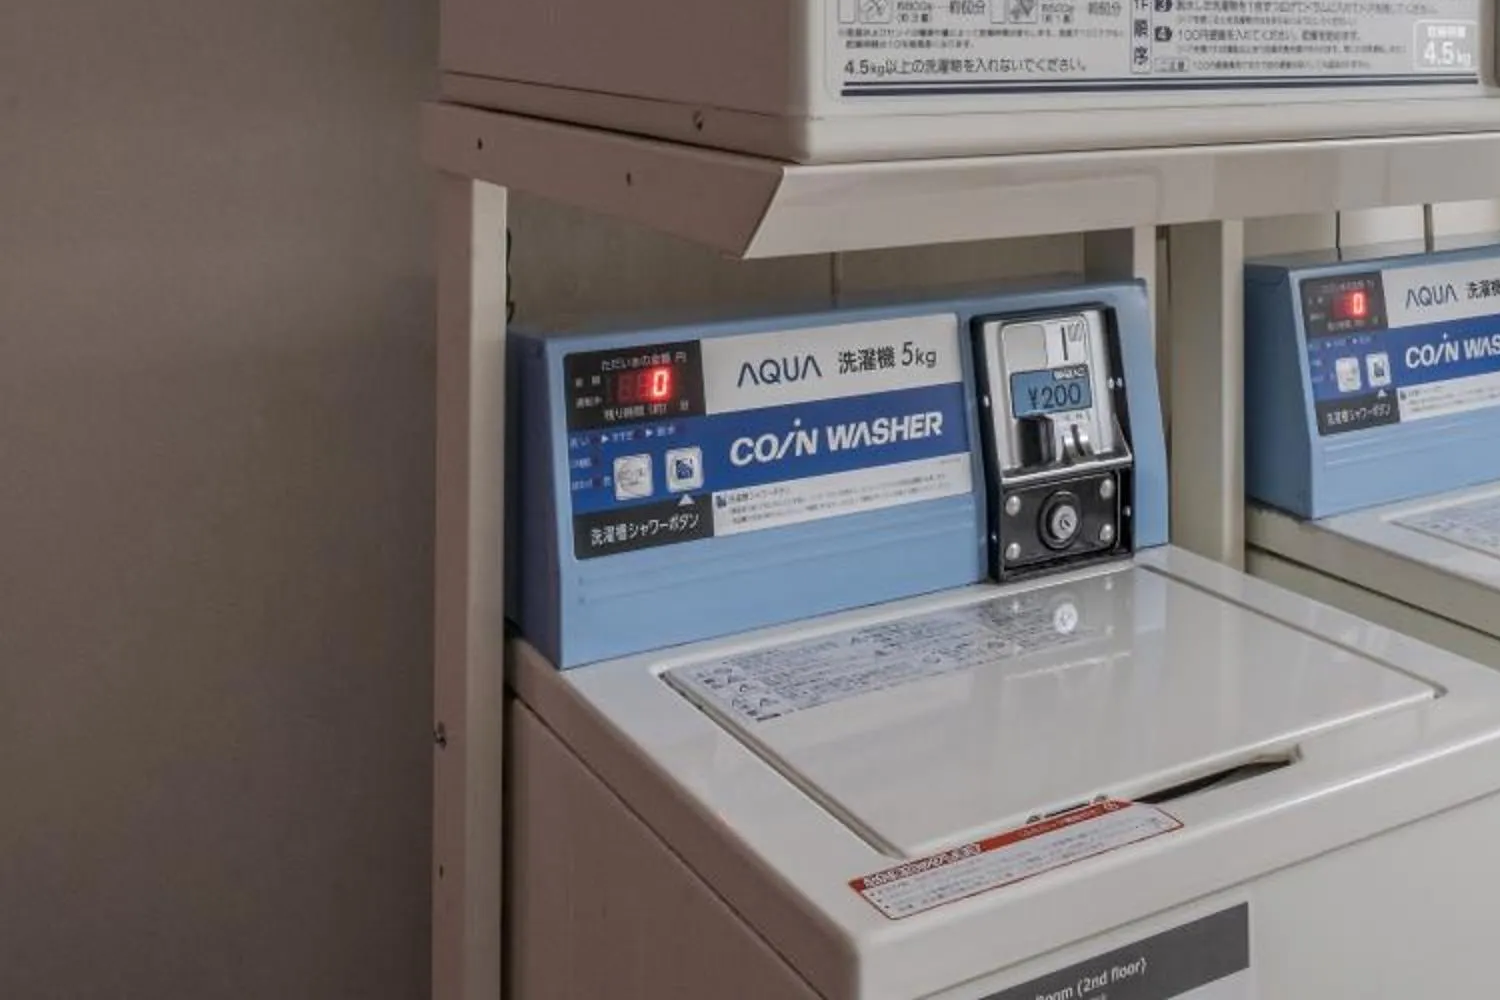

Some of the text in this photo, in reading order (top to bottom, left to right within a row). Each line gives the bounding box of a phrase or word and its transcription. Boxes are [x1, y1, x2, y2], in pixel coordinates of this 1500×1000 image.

[1404, 282, 1460, 310] AQUA
[736, 340, 938, 388] AQUA 洗濯機 5kg
[653, 369, 669, 397] 0
[1027, 382, 1081, 410] ¥200
[825, 411, 944, 452] WASHER
[591, 513, 700, 547] 洗濯槽シャワーボタン
[1077, 968, 1108, 998] (2nd
[1111, 957, 1148, 984] floor)
